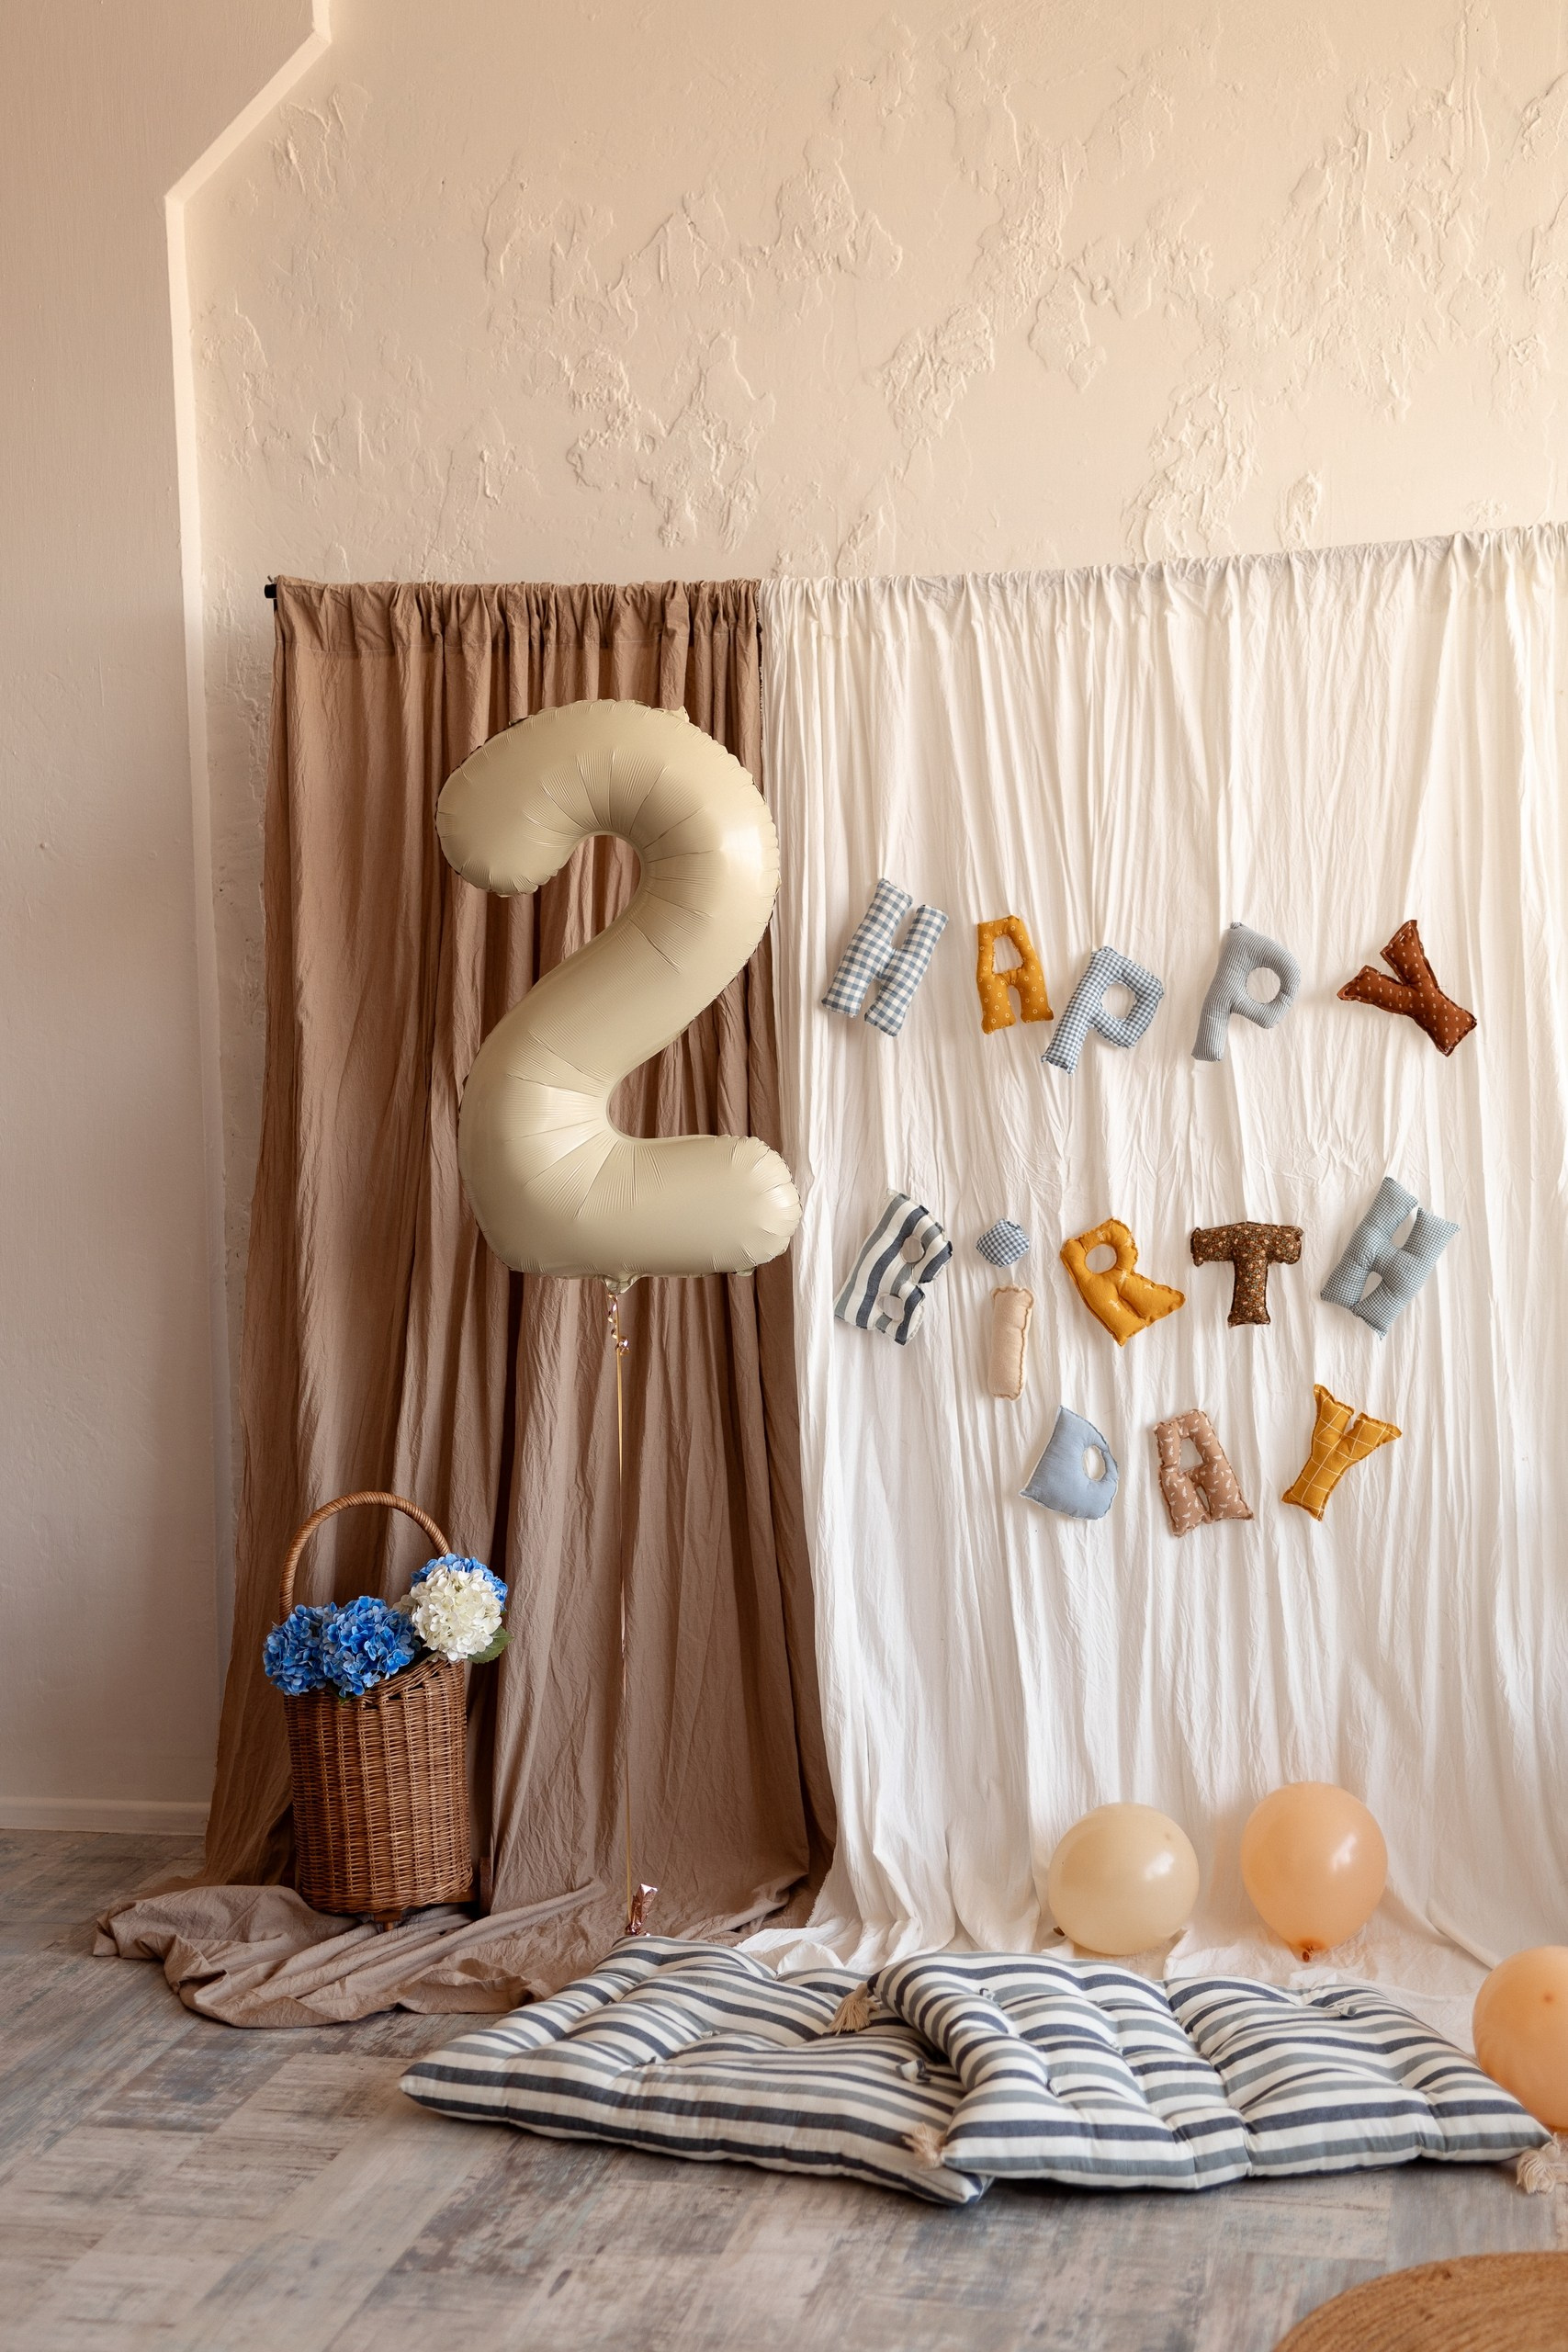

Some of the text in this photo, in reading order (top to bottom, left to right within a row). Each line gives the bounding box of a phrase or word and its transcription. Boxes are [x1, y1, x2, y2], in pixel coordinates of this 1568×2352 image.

[435, 699, 802, 1280] 2
[821, 878, 1477, 1074] HAPPY
[1020, 1384, 1402, 1537] DAY
